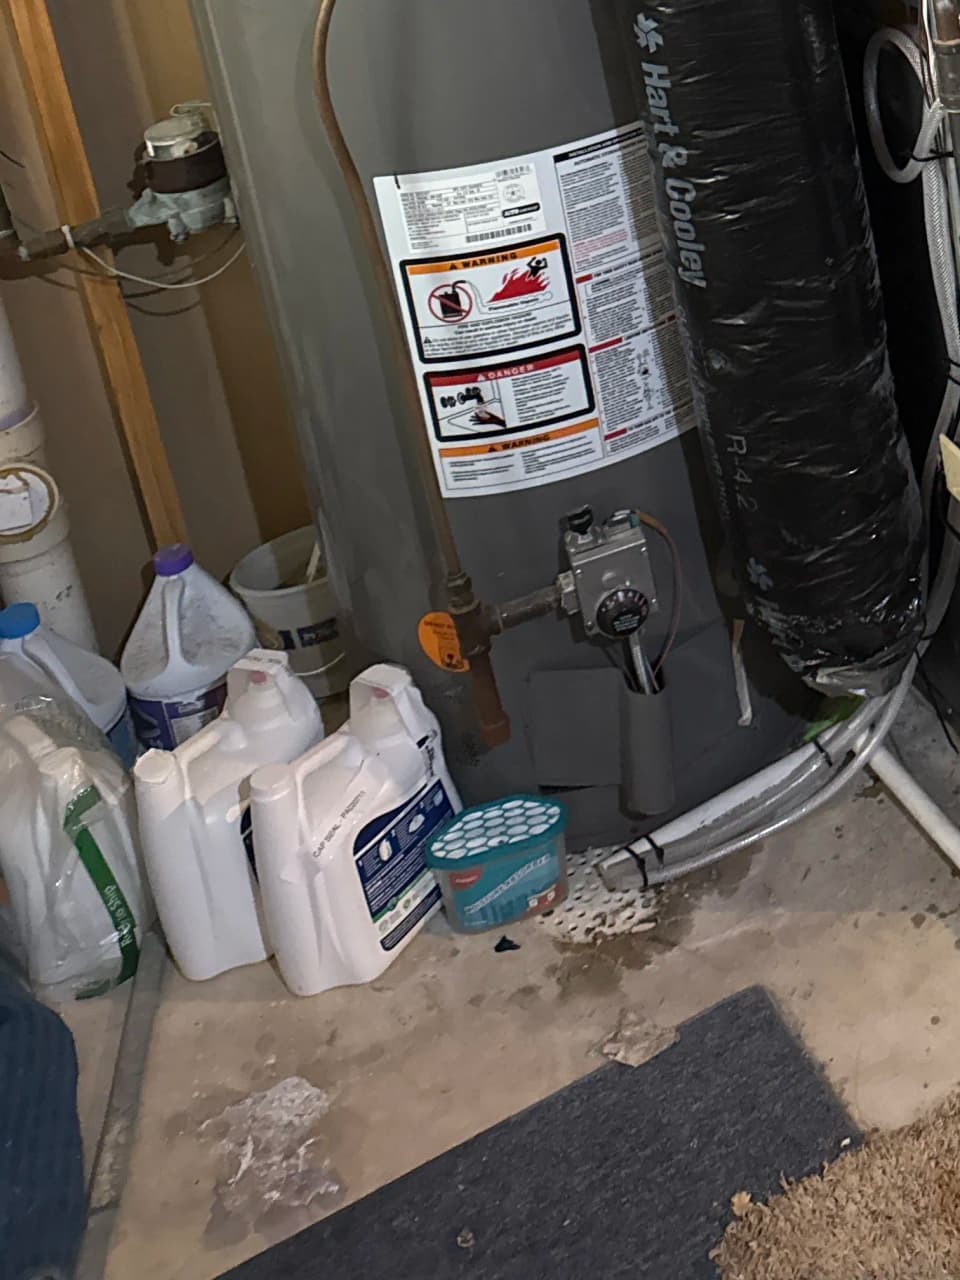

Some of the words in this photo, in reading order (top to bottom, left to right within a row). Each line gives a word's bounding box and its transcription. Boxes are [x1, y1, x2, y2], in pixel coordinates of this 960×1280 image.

[641, 61, 680, 137] Hart
[658, 141, 688, 170] &
[666, 177, 708, 289] Cooley
[461, 252, 518, 268] WARNING
[487, 364, 535, 380] DANGER
[501, 434, 550, 450] WARNING
[725, 434, 758, 513] R-4.2
